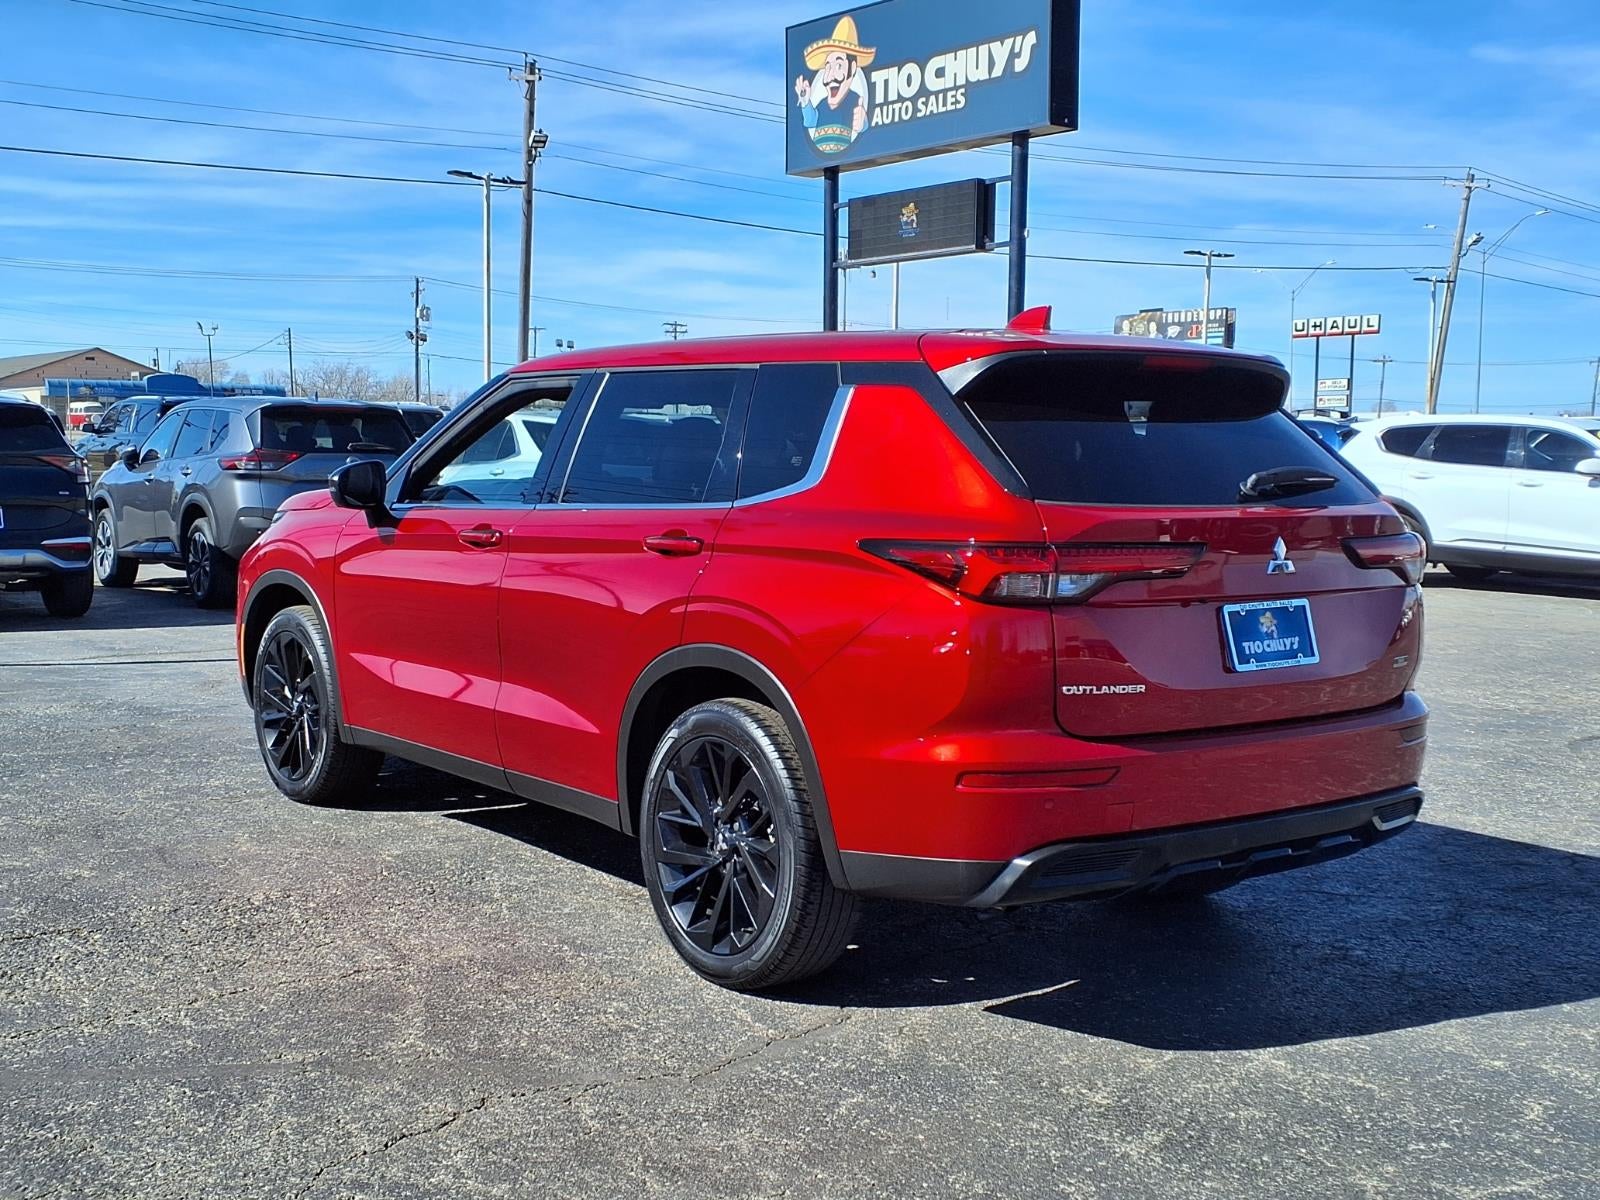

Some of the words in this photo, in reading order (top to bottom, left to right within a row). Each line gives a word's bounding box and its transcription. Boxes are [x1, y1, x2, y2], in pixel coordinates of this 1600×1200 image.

[871, 62, 922, 104] TIO
[924, 30, 1037, 92] CHUY'S
[872, 100, 913, 127] AUTO
[917, 88, 966, 118] SALES
[1209, 308, 1226, 320] UP!
[1242, 640, 1263, 654] TIO
[1062, 685, 1146, 695] OUTLANDER
